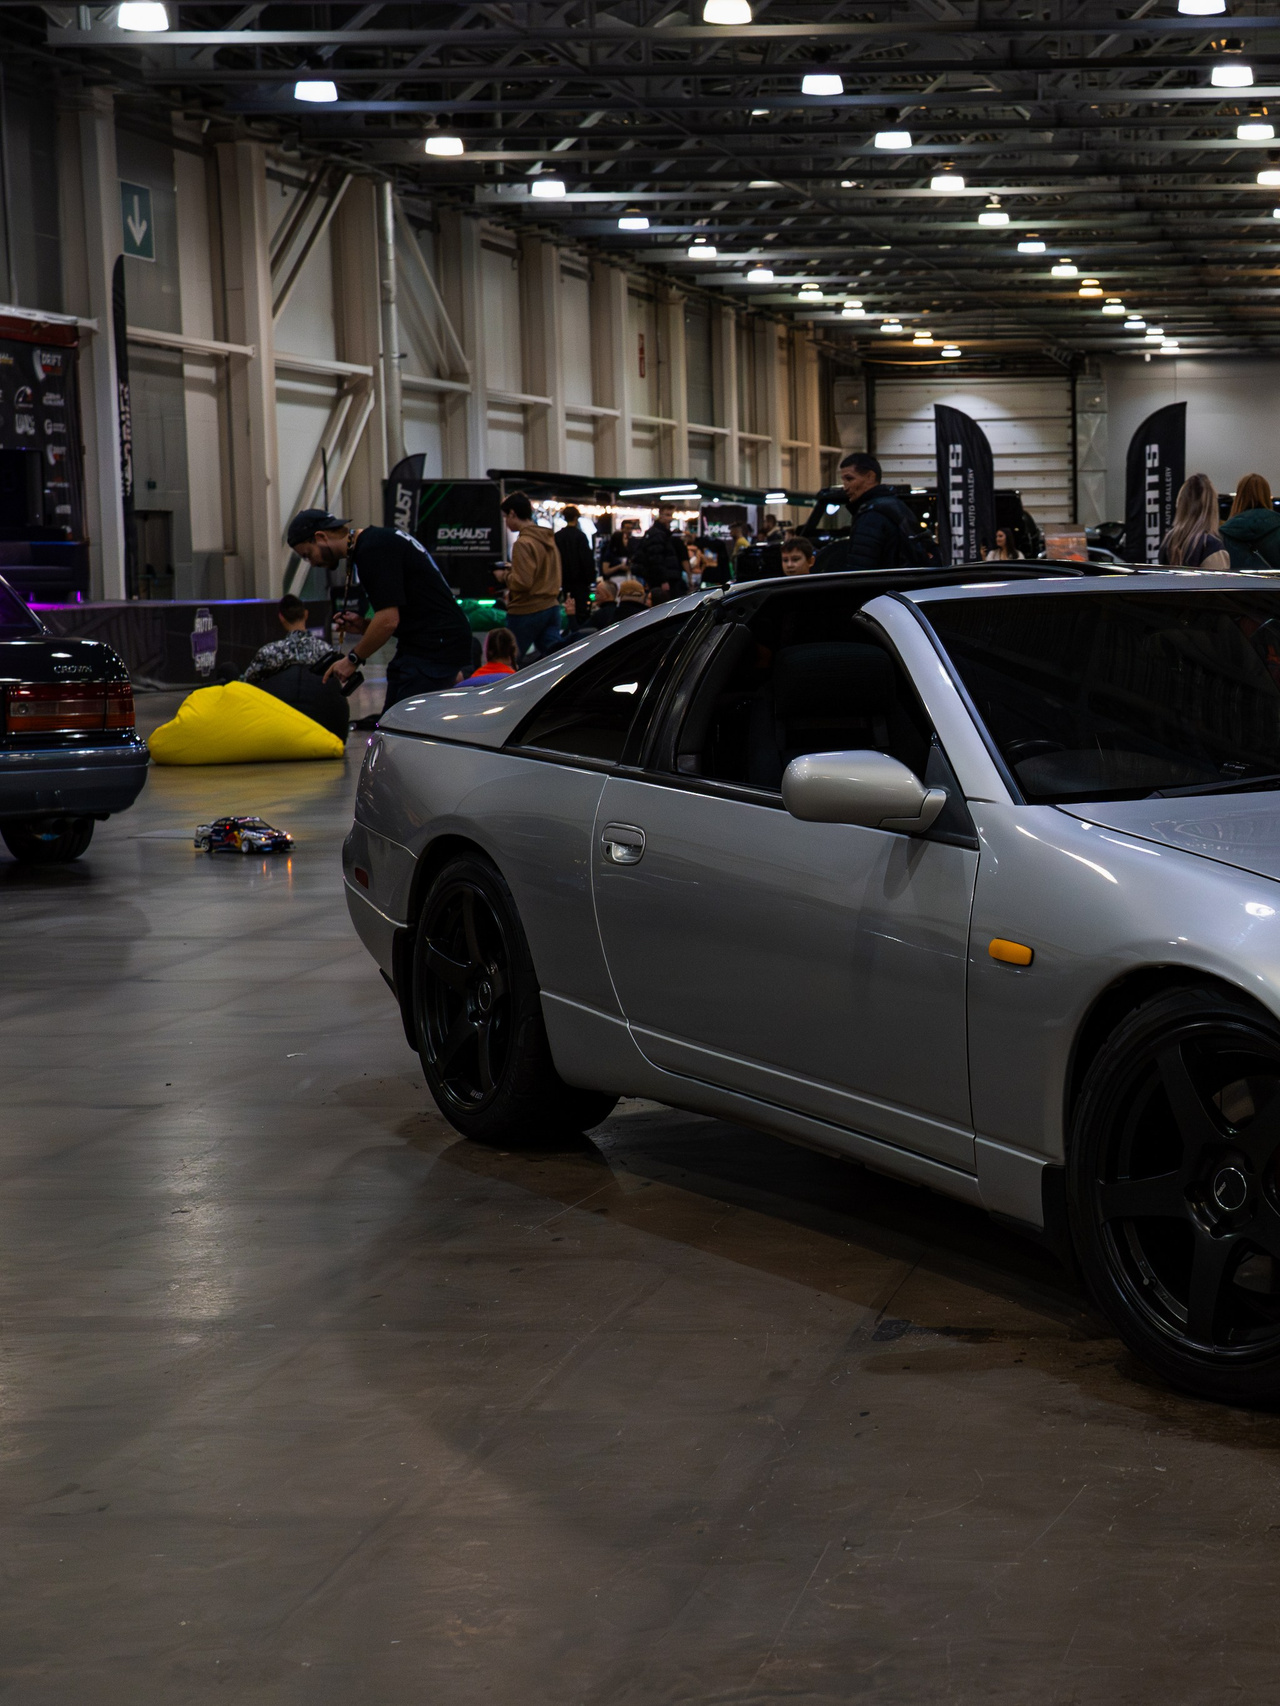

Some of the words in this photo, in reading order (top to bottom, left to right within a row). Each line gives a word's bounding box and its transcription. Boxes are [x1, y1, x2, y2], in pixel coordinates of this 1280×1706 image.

[42, 352, 62, 367] DRIFT
[967, 467, 975, 503] GALLERY
[1164, 466, 1172, 502] GALLERY
[393, 482, 414, 533] AUST
[949, 444, 964, 566] REATS
[968, 504, 976, 527] AUTO
[1145, 444, 1159, 564] REATS
[436, 527, 492, 540] EXHAUST
[195, 616, 213, 633] AUTO
[53, 664, 93, 674] CROWN
